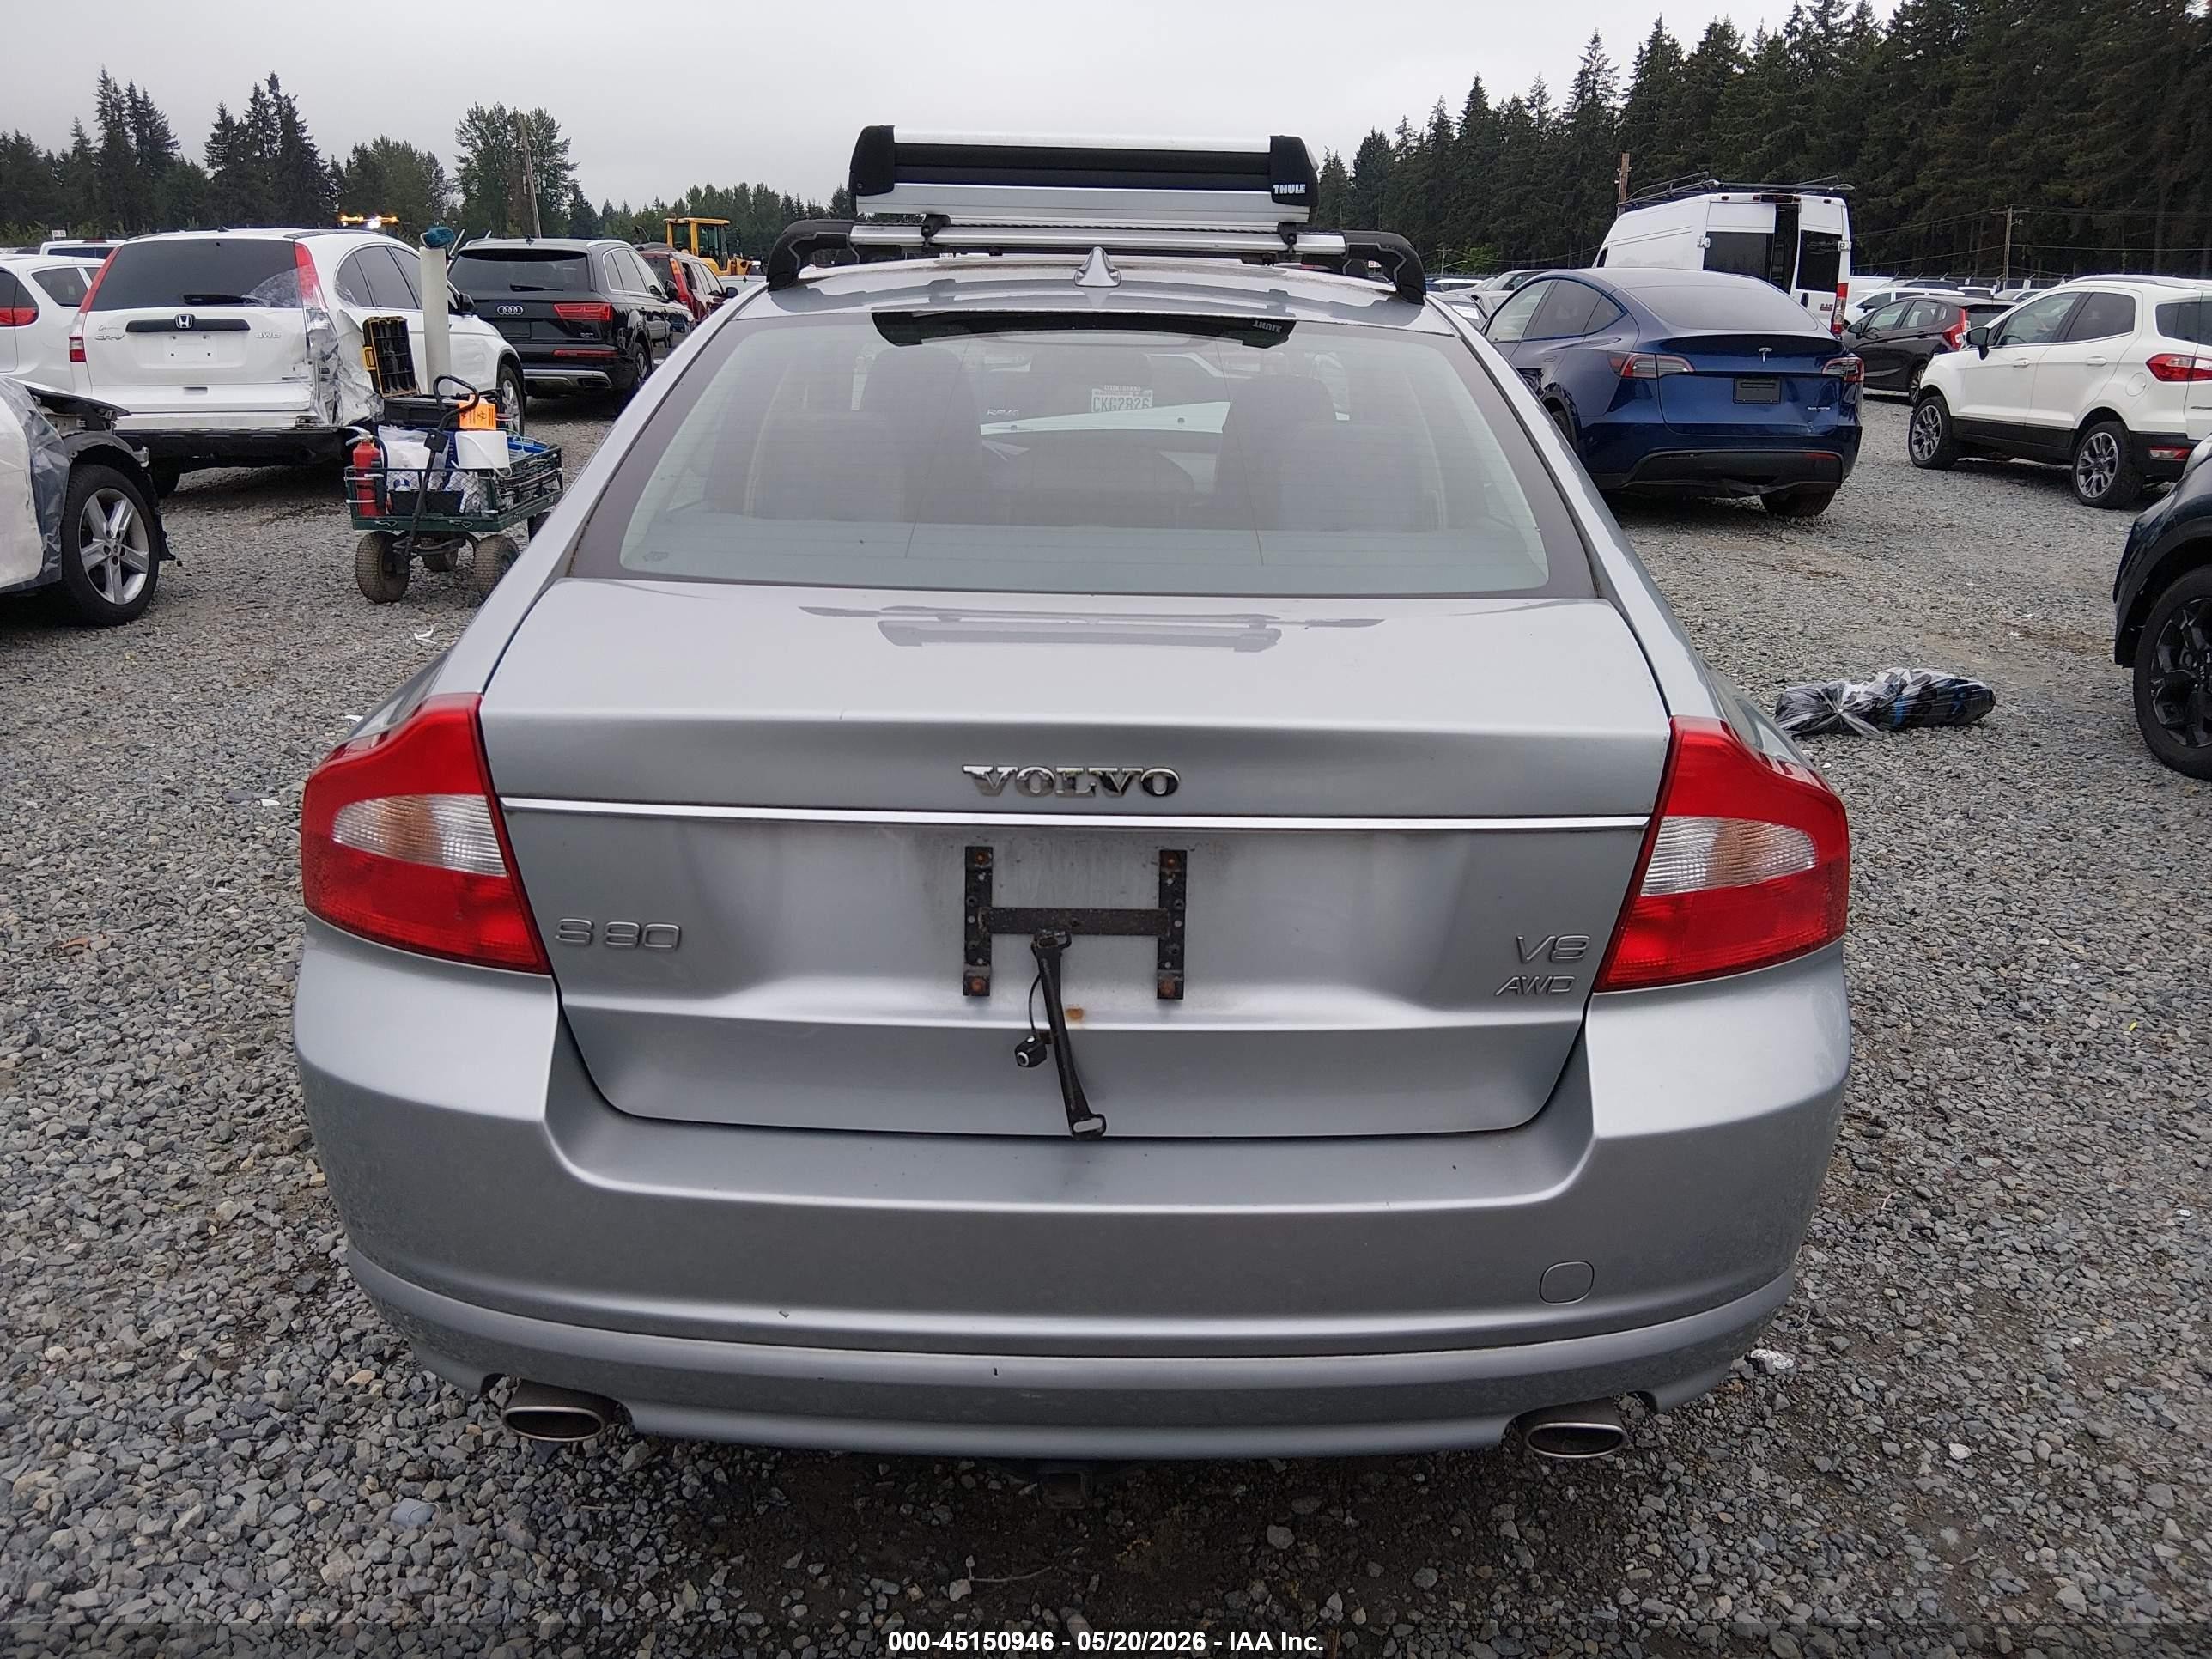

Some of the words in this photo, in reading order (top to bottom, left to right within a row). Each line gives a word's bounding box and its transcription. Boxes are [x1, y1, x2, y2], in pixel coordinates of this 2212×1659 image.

[1273, 184, 1306, 194] THULE
[962, 764, 1181, 798] VOLVO
[1516, 933, 1591, 963] V8
[1494, 975, 1576, 996] AWD
